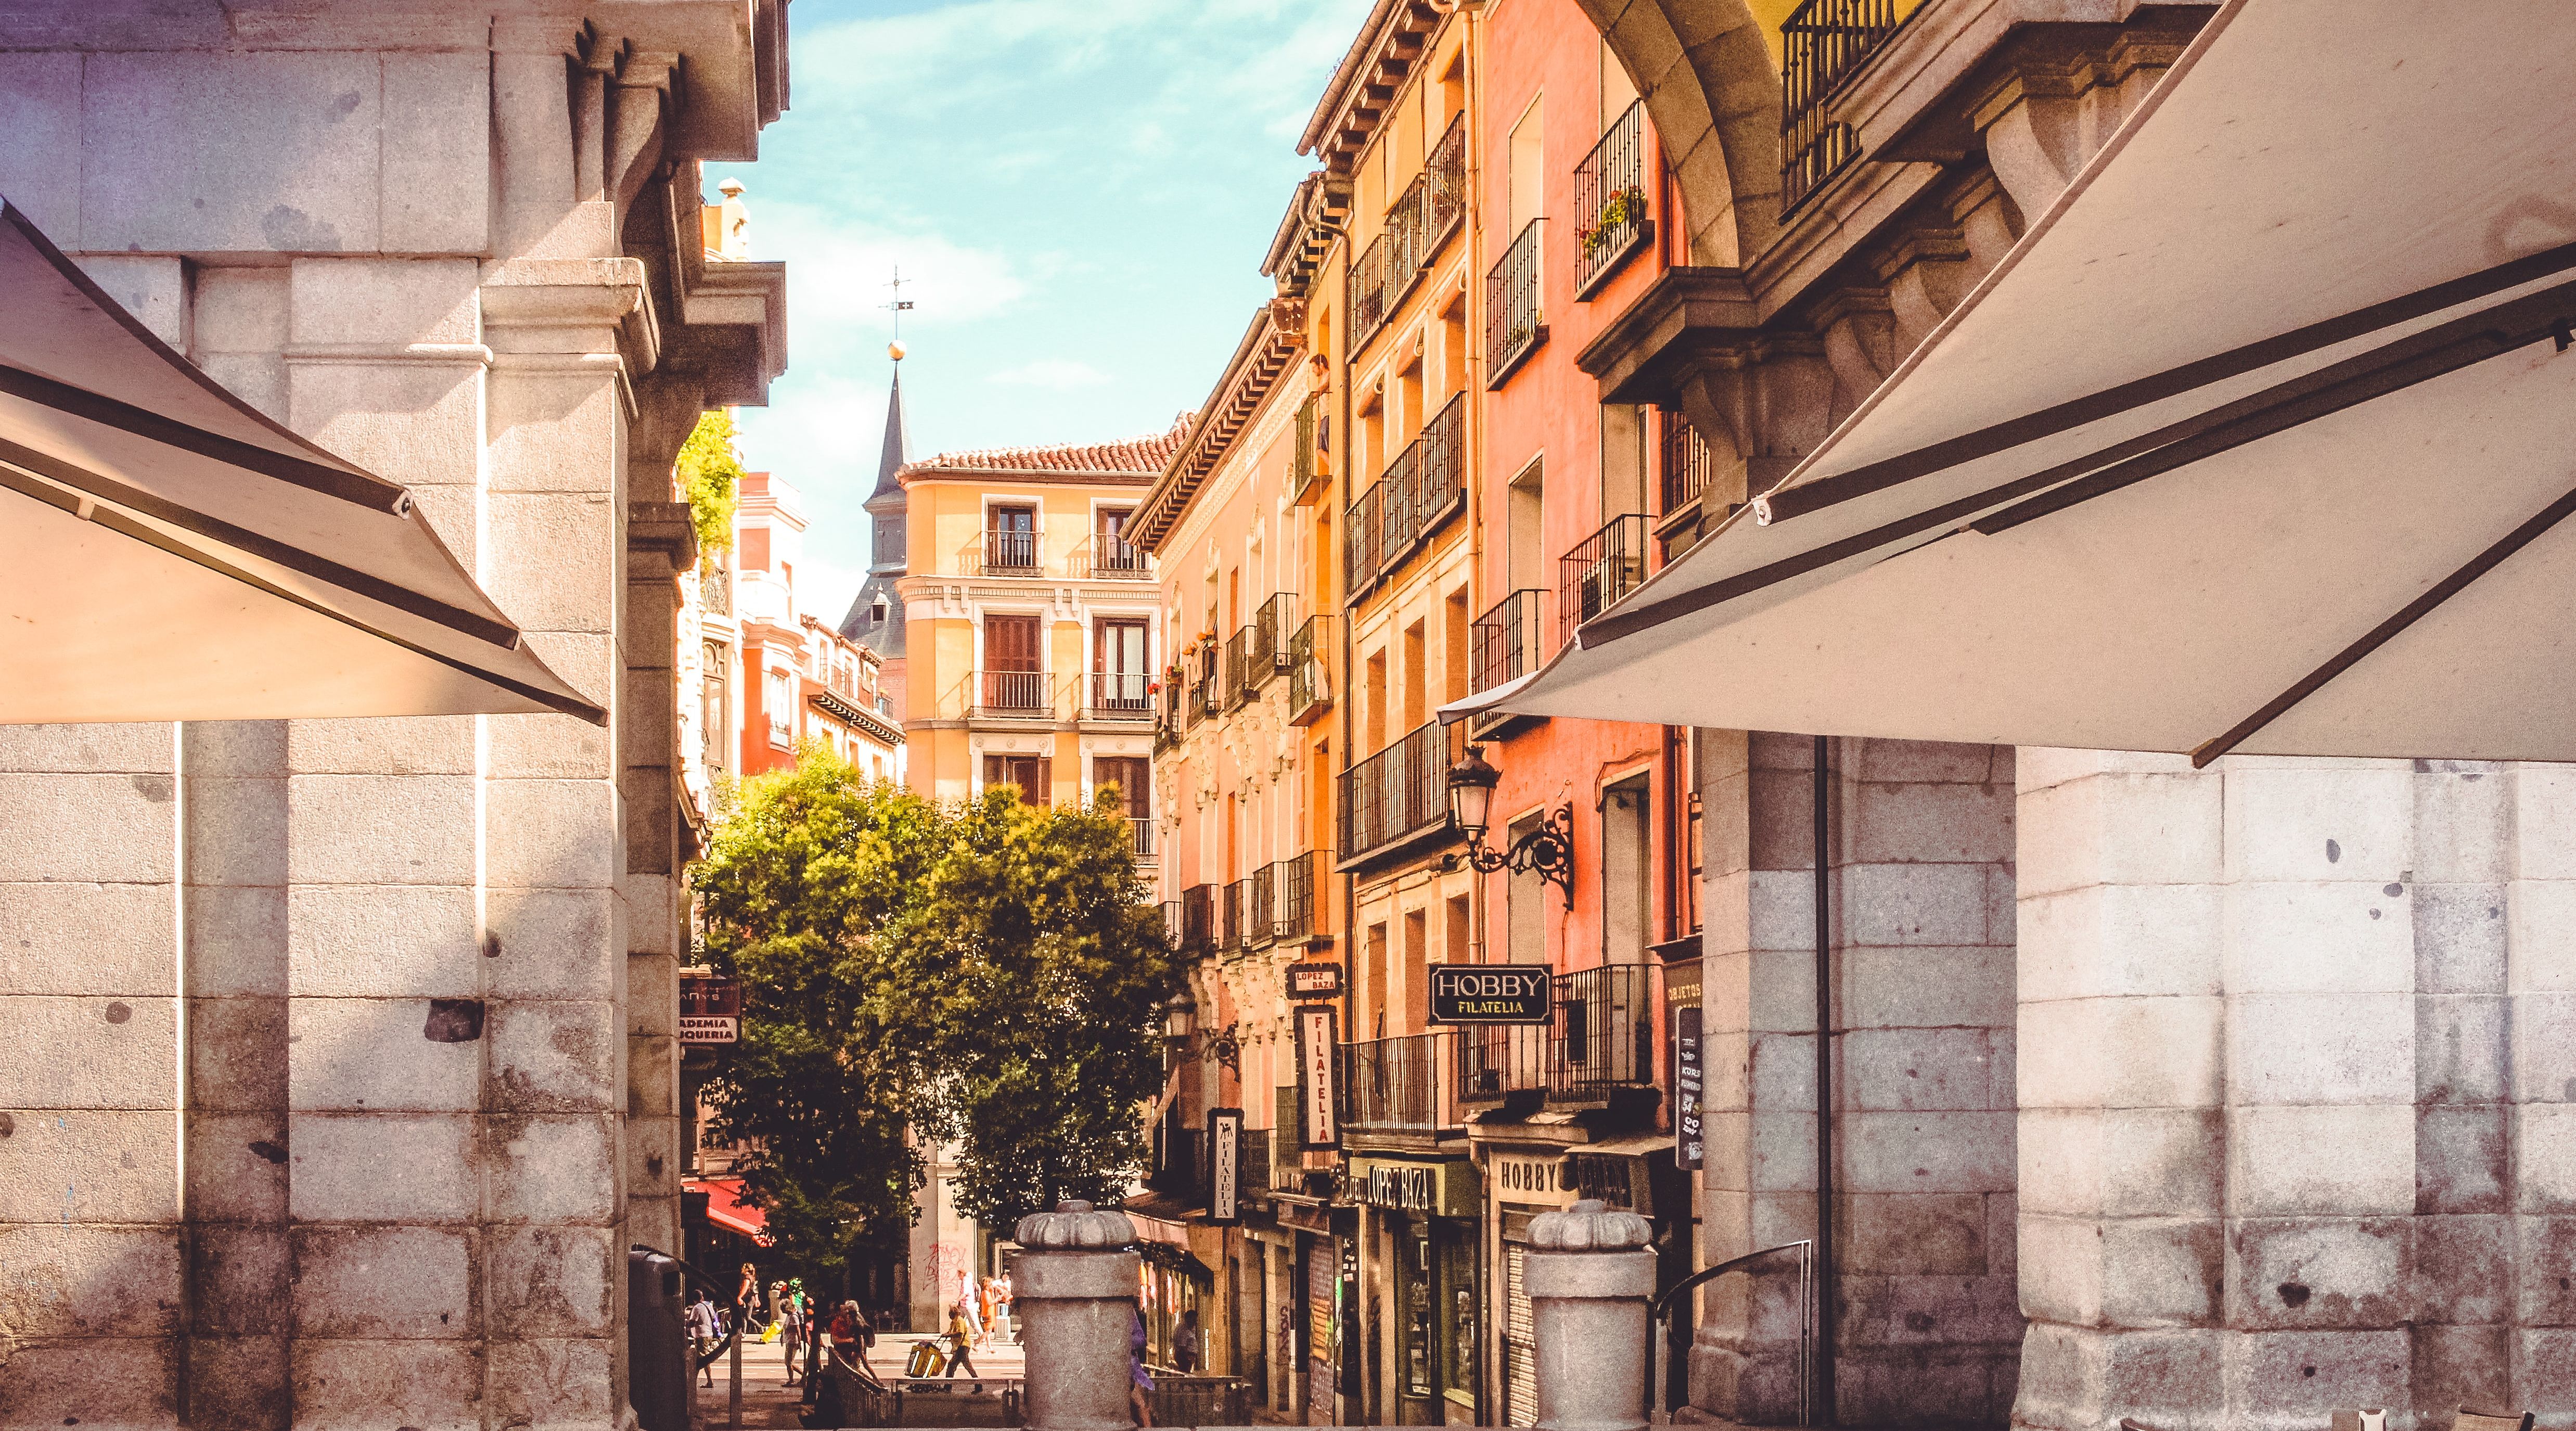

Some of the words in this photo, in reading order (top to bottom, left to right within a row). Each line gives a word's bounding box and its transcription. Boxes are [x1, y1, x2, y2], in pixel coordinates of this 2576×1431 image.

[1439, 975, 1543, 996] HOBBY
[1457, 1001, 1524, 1013] FILATELIA
[1315, 1016, 1327, 1141] FILATELIA
[1220, 1141, 1232, 1217] FILATELIA
[1367, 1165, 1399, 1210] LOPEZ
[1401, 1167, 1429, 1210] BAZA
[1502, 1161, 1556, 1193] HOBBY
